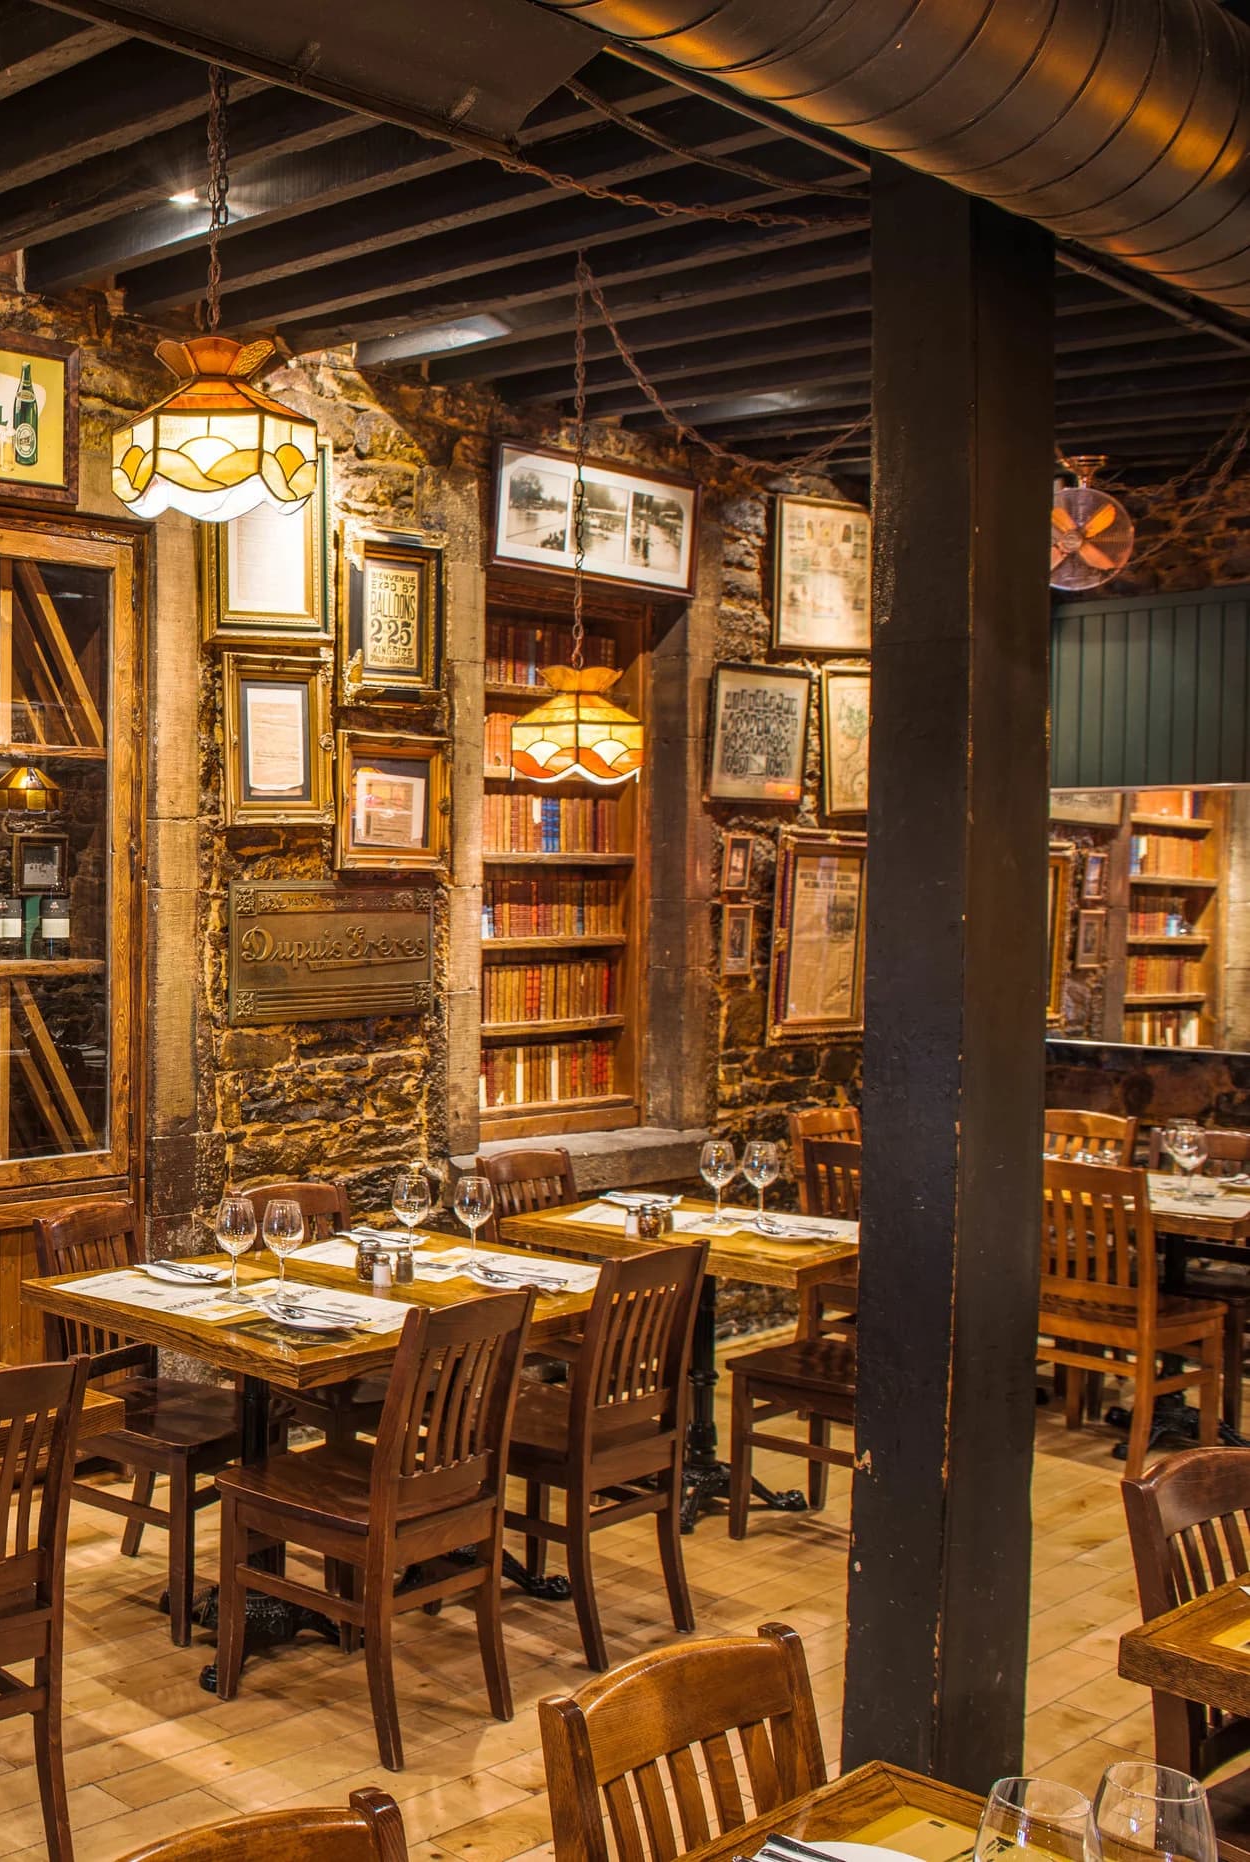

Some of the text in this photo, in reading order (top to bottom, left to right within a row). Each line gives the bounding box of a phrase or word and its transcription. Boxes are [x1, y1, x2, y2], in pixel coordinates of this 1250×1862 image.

[371, 571, 417, 585] BIENVENUE
[371, 581, 398, 592] EXPO
[370, 591, 416, 621] BALLOONS
[371, 618, 383, 644] 2
[241, 925, 426, 969] Dupuis Frères
